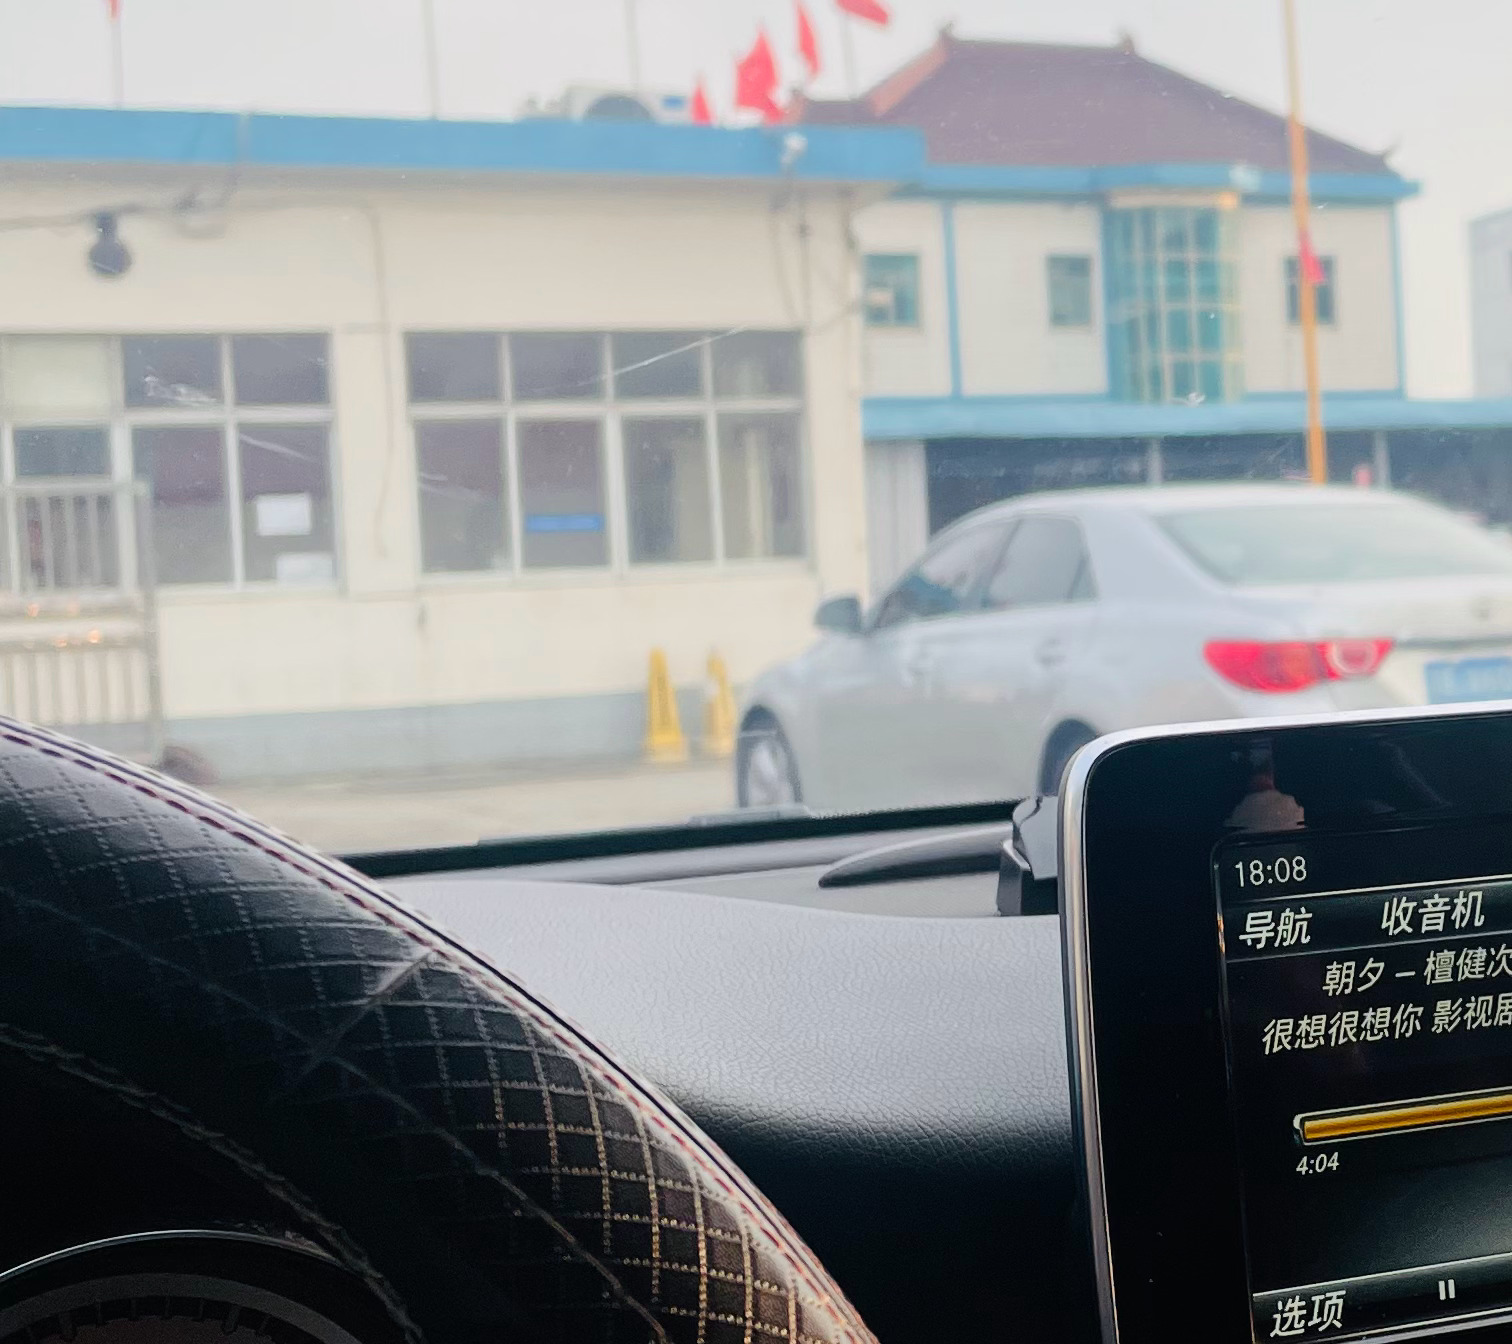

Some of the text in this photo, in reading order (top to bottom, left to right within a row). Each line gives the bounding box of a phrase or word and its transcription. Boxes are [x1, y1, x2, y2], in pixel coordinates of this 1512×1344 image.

[1234, 856, 1308, 888] 18:08
[1239, 907, 1313, 950] 导航
[1381, 891, 1485, 936] 收音机
[1322, 958, 1386, 997] 朝夕
[1261, 1003, 1425, 1056] 很想很想你
[1295, 1152, 1341, 1176] 4:04
[1269, 1290, 1347, 1338] 选项
